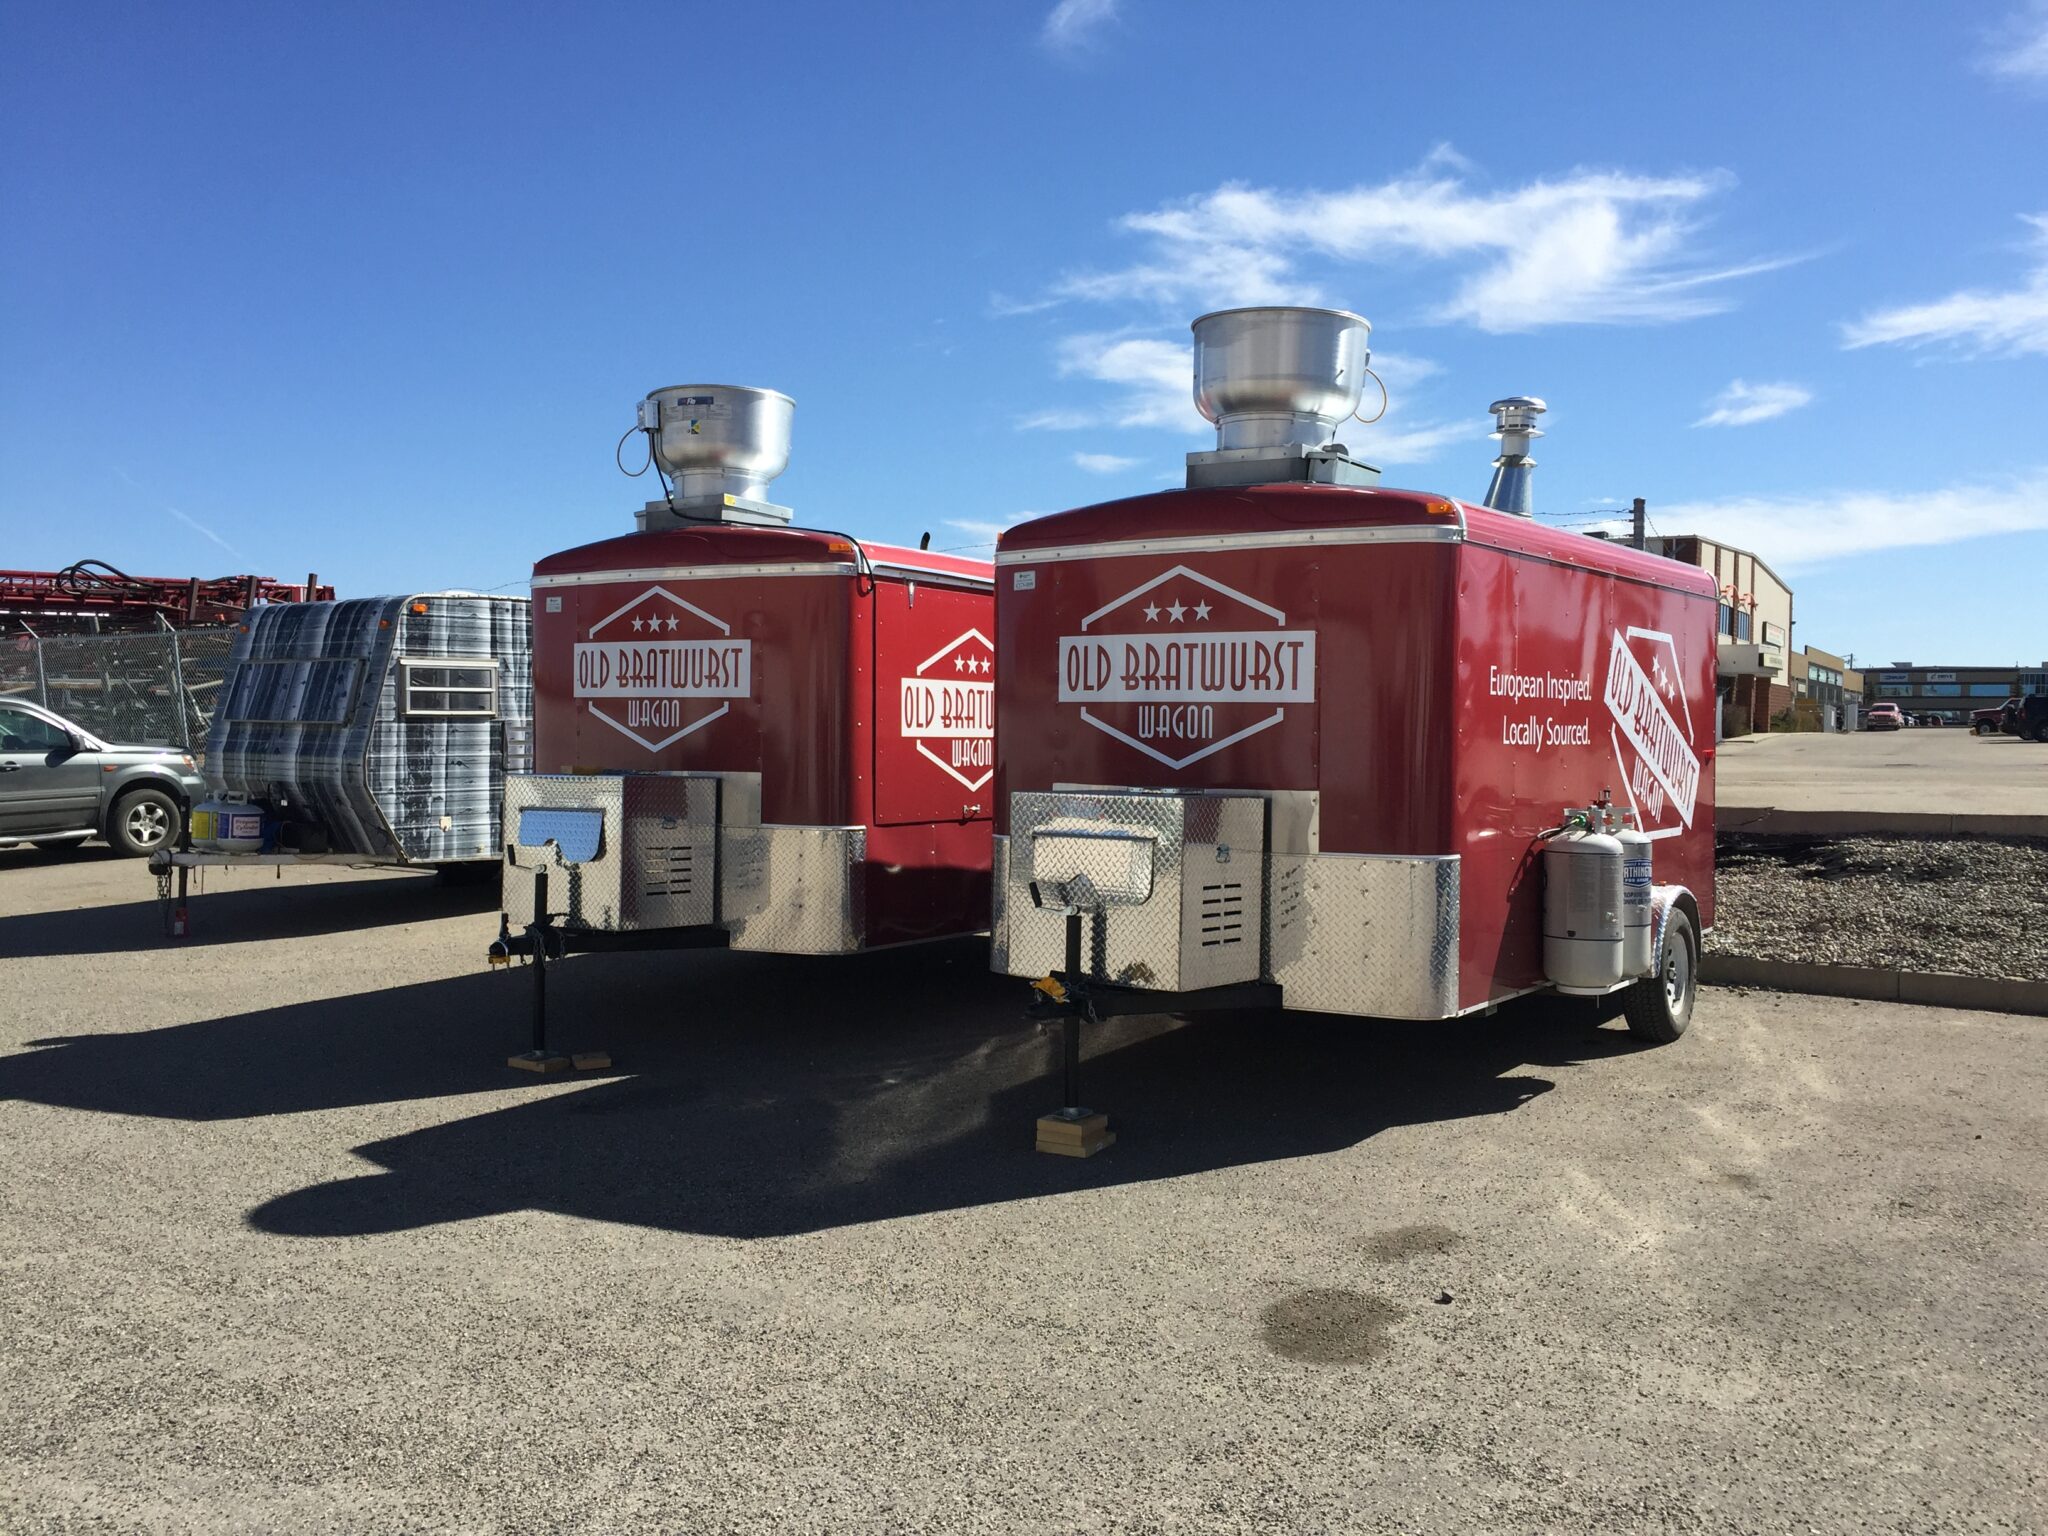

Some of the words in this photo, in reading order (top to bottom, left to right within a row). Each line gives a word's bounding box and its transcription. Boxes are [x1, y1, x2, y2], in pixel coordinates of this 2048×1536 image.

[579, 649, 610, 689] OLD
[616, 647, 743, 689] BRATWURST
[1066, 643, 1112, 692] OLD
[1119, 640, 1304, 692] BRATWURST
[1489, 665, 1544, 705] European
[1547, 670, 1592, 707] Inspired.
[628, 699, 680, 728] WAGON
[904, 686, 935, 729] OLD
[940, 686, 994, 730] BRATW
[1138, 704, 1213, 740] WAGON
[1502, 714, 1544, 753] Locally
[1546, 716, 1591, 746] Sourced.
[1611, 648, 1634, 716] OLD
[1633, 681, 1696, 812] BRATWURST
[952, 739, 992, 768] WAGON
[1632, 755, 1664, 824] WAGON
[1623, 866, 1652, 878] RTHING
